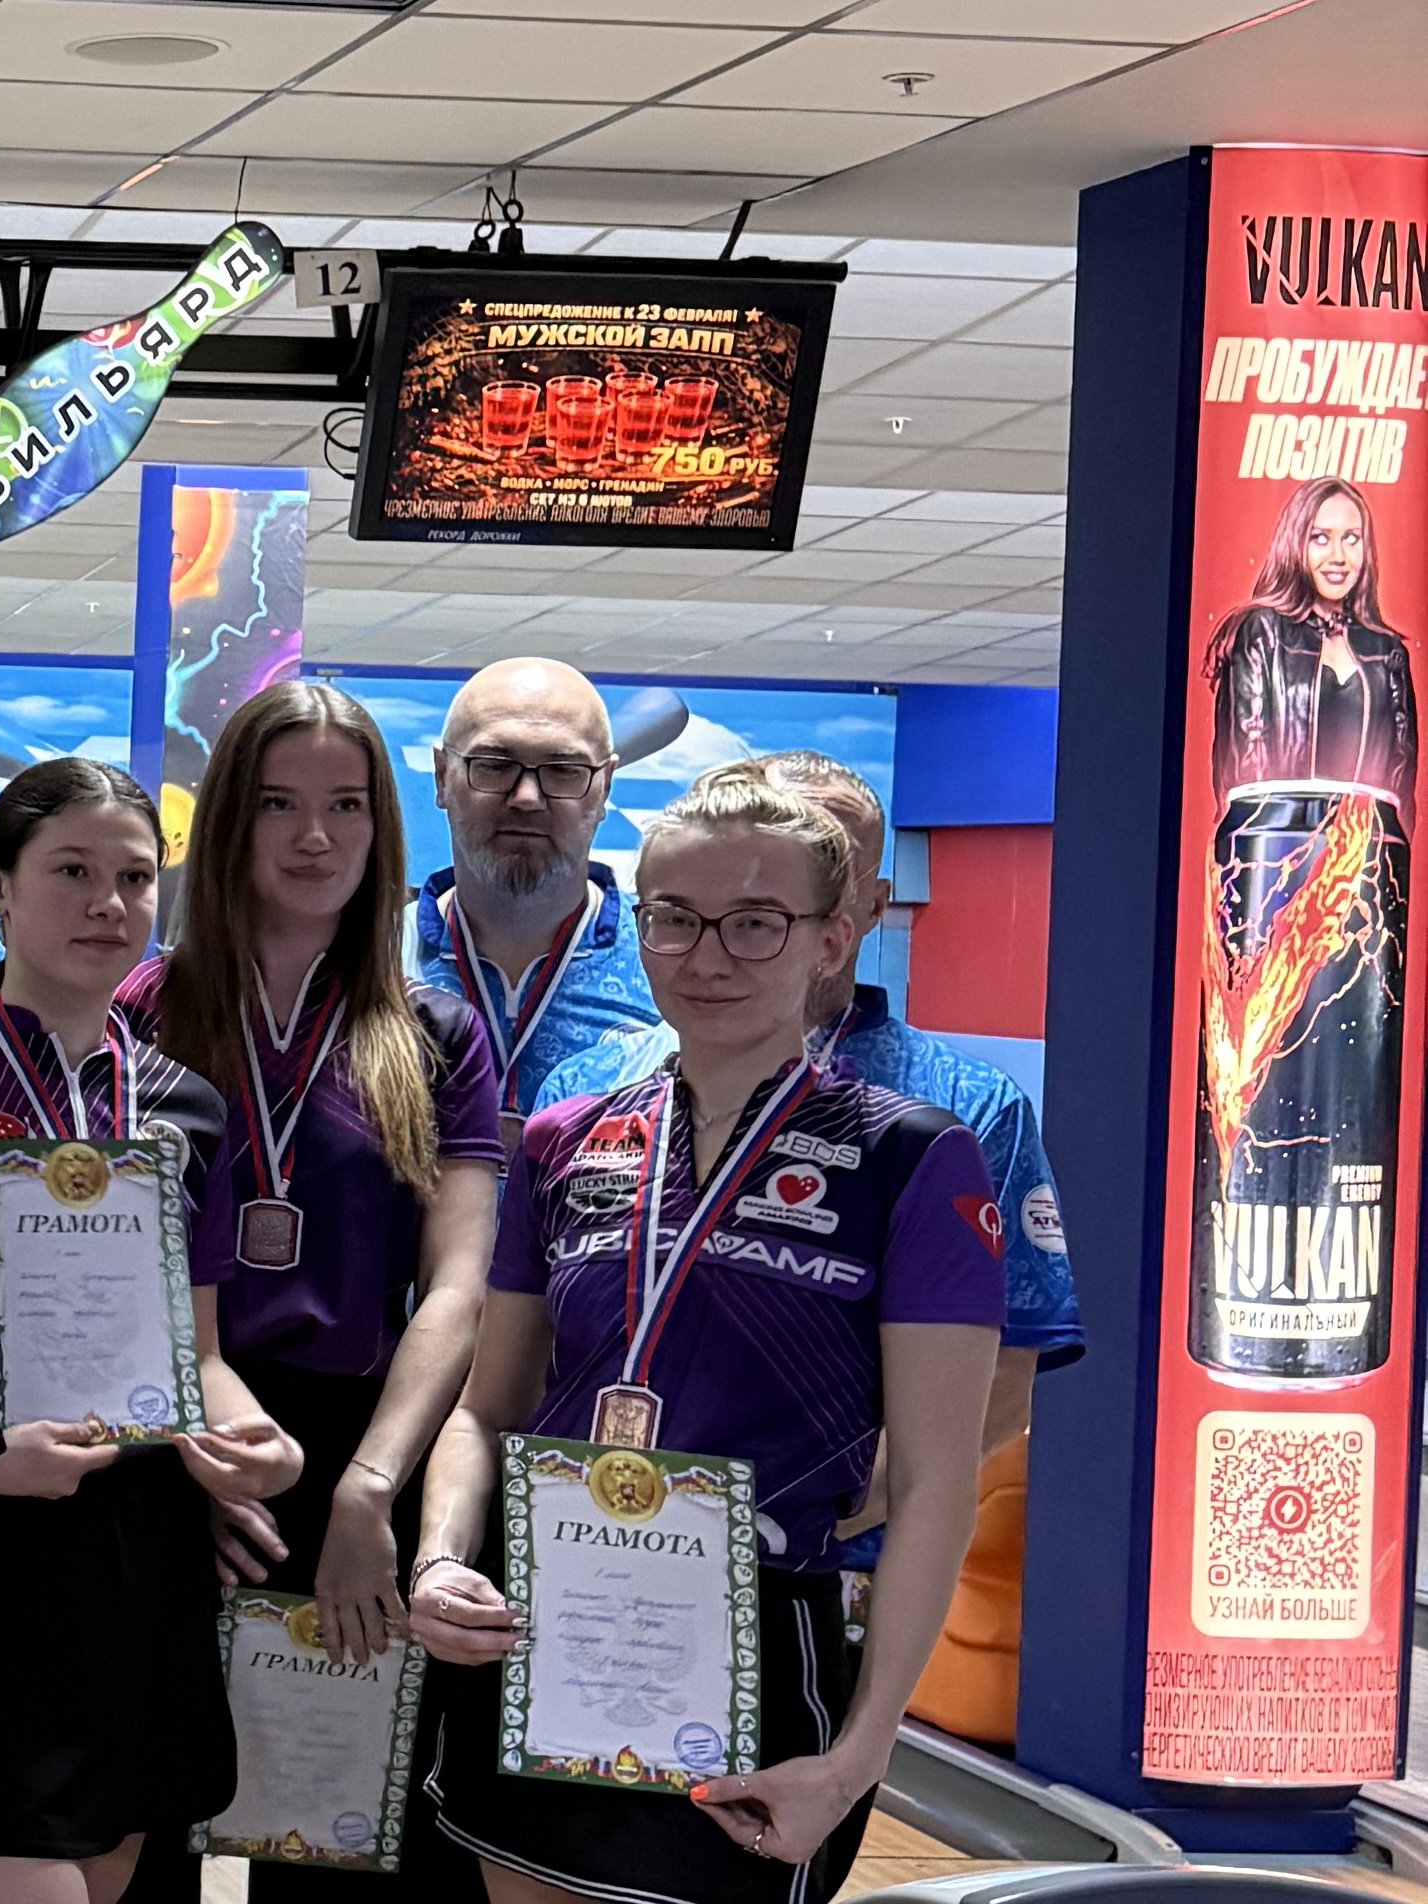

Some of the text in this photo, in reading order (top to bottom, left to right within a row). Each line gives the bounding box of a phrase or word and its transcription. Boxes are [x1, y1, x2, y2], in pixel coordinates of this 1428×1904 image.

[317, 263, 360, 297] 12
[624, 307, 634, 319] К
[636, 305, 660, 320] 23
[664, 308, 737, 322] ФЕВРАЛЯ!
[488, 324, 734, 355] МУЖСКОЙ ЗАЛП
[1204, 336, 1428, 414] ПРОБУЖДАЕ
[651, 447, 778, 476] 750 РУБ.
[1238, 414, 1407, 483] ПОЗИТИВ
[16, 1212, 143, 1236] ГРАМОТА
[1211, 1201, 1381, 1299] VULKAN
[1230, 1308, 1357, 1331] ОРИГИНАЛЬНЫЙ
[553, 1520, 706, 1559] ГРАМОТА
[1209, 1593, 1358, 1622] УЗНАЙ БОЛЬШЕ
[249, 1650, 381, 1683] ГРАМОТА
